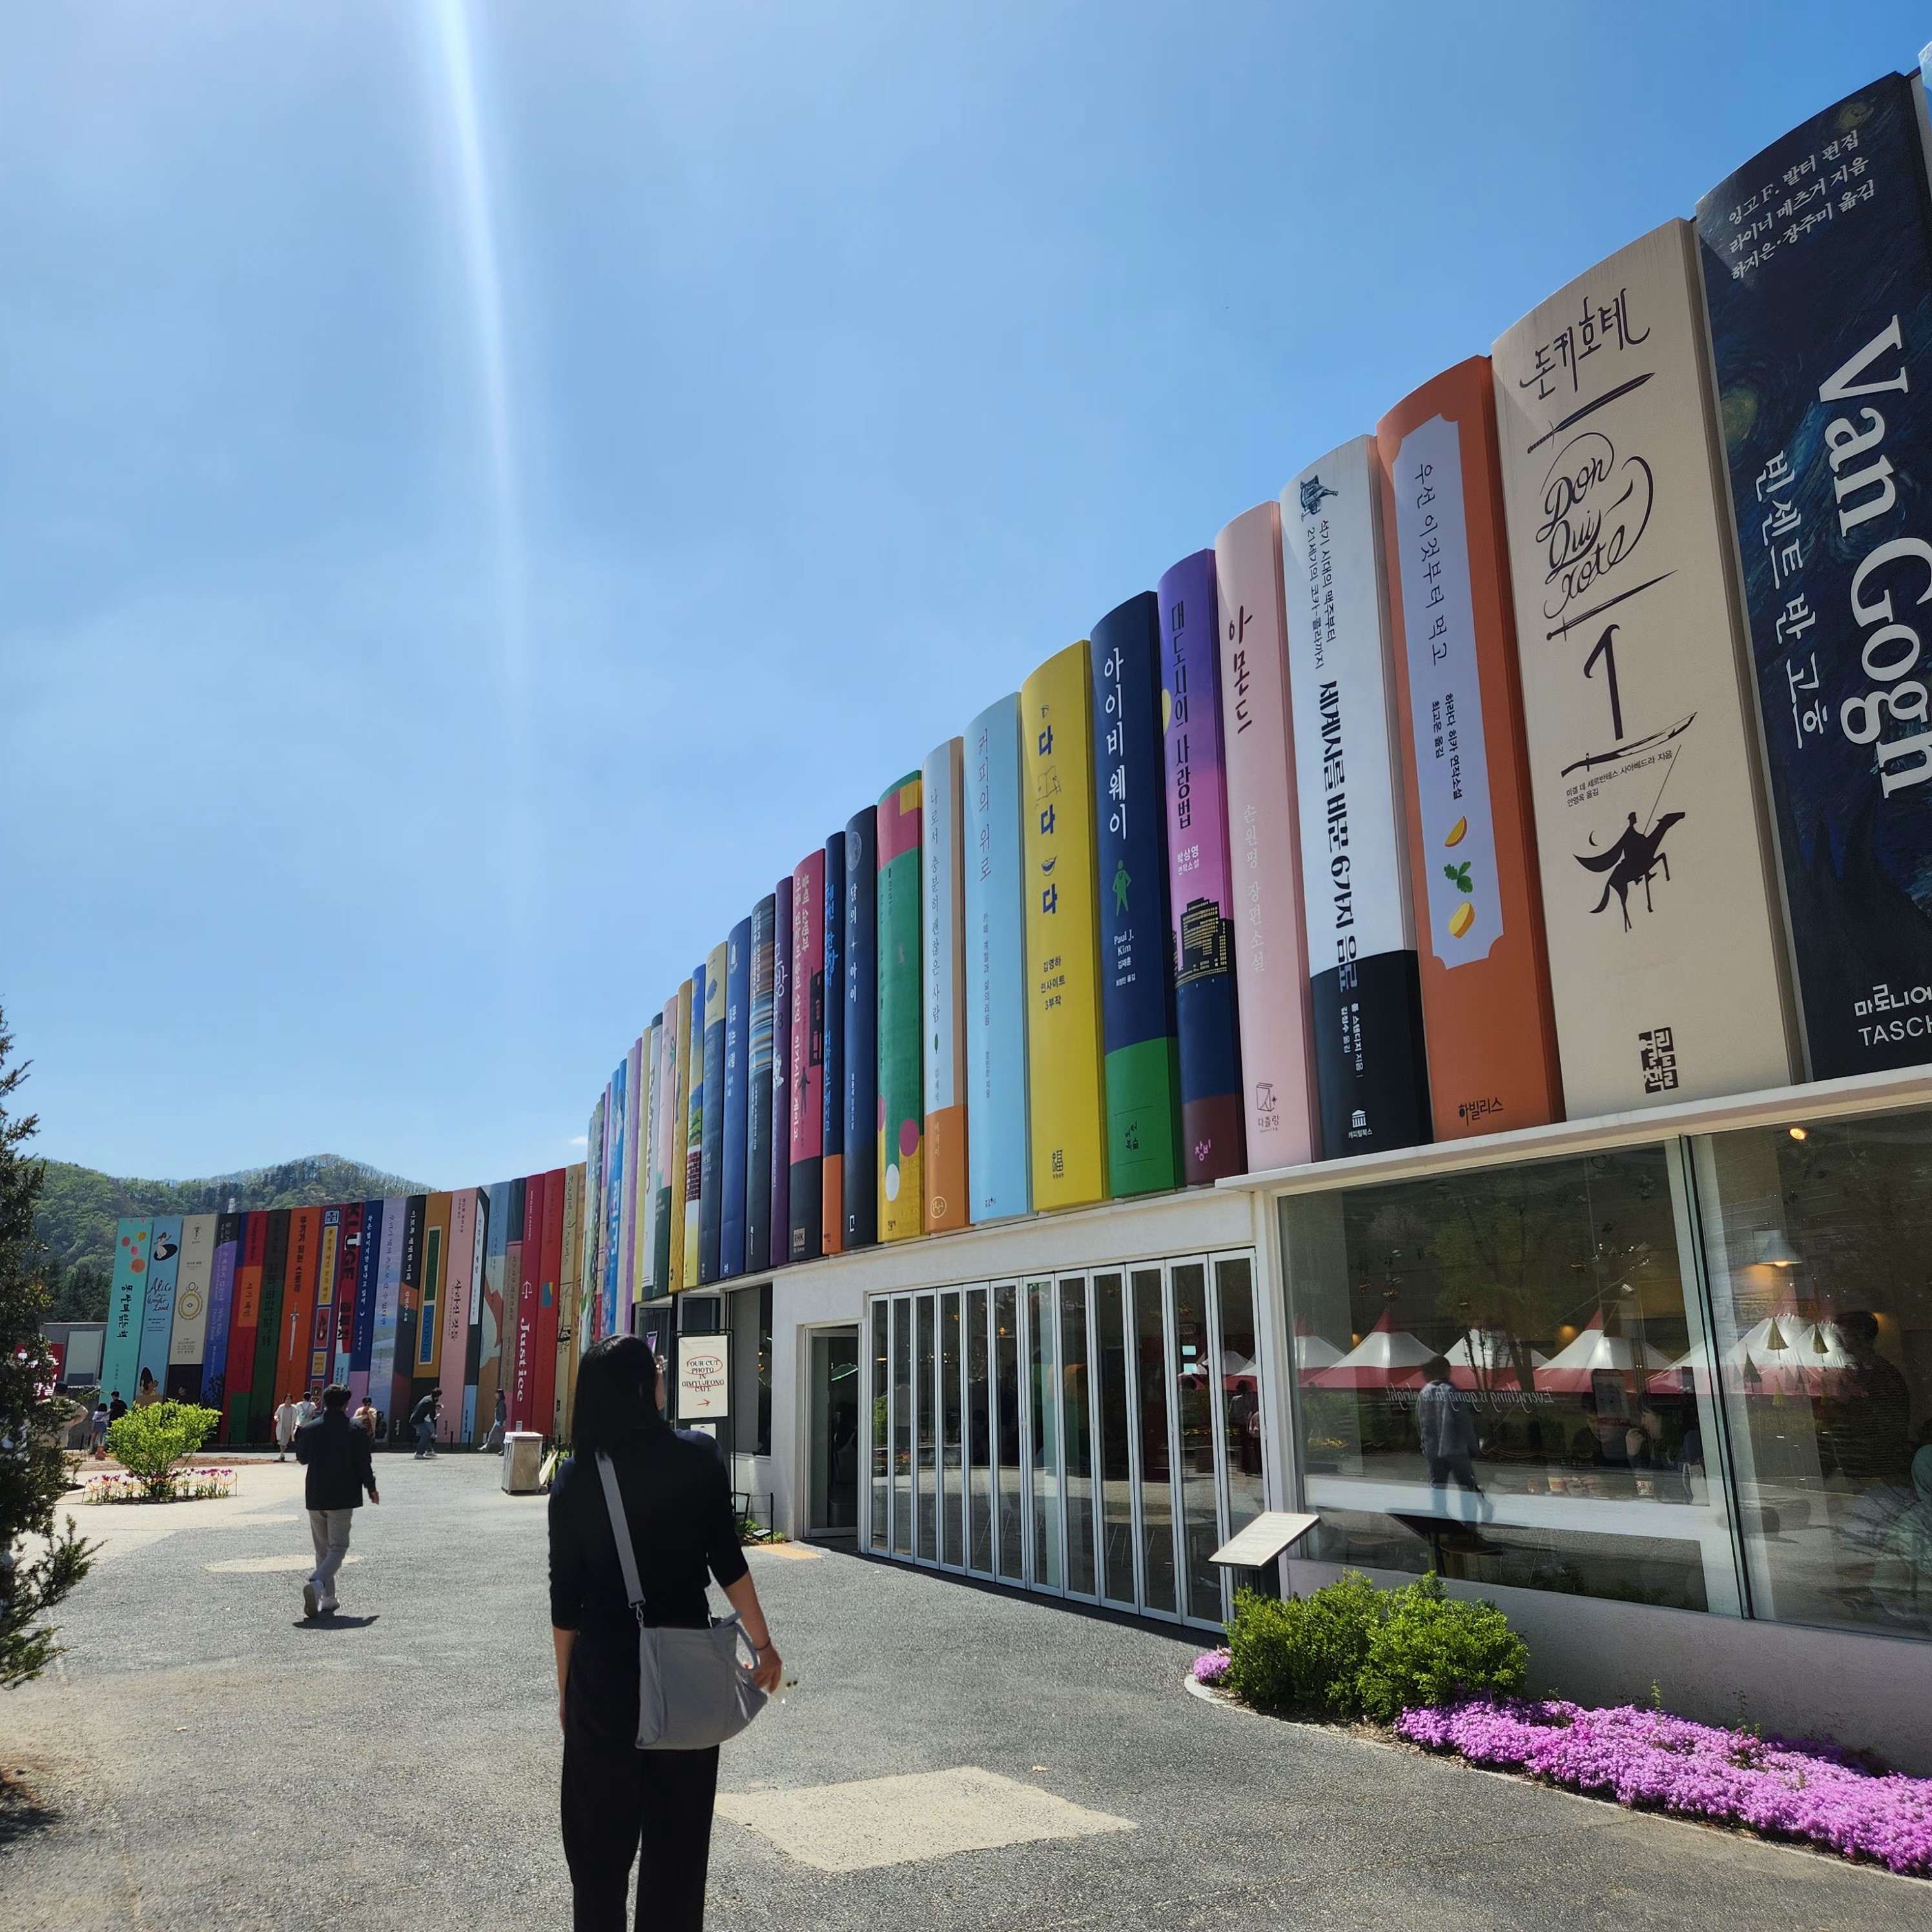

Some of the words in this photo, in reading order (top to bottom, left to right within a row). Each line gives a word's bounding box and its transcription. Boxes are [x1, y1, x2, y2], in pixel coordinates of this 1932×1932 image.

[1729, 195, 1759, 225] 잉고
[1761, 183, 1780, 203] F.
[1783, 155, 1816, 187] 발터
[1822, 130, 1859, 161] 편집
[1838, 179, 1875, 213] 옮김
[1729, 213, 1773, 253] 라이너
[1776, 178, 1827, 220] 메츠거
[1830, 156, 1869, 189] 지음
[1520, 288, 1650, 400] 돈키호테
[1818, 314, 1909, 539] Van
[1415, 463, 1437, 509] 우선
[1536, 439, 1614, 544] Don
[1319, 519, 1330, 546] 석기
[1756, 450, 1804, 590] 빈센트
[1307, 527, 1319, 582] 21세기의
[1322, 550, 1333, 588] 시대의
[1419, 515, 1445, 609] 이것부터
[1310, 584, 1324, 670] 코카-콜라까지
[1323, 590, 1337, 644] 맥주부터
[1777, 592, 1816, 644] 반
[1428, 615, 1448, 666] 먹고
[1171, 601, 1188, 728] 대도시의
[1229, 604, 1253, 734] 아몬드
[1584, 624, 1623, 741] 1
[1840, 537, 1932, 799] Gogh
[1432, 700, 1443, 734] 최고은
[1444, 692, 1456, 727] 하라다
[1786, 652, 1829, 749] 고흐
[1038, 724, 1054, 756] 다
[1104, 646, 1127, 841] 아이비웨이
[1319, 680, 1345, 793] 세계사를
[1434, 735, 1444, 759] 옮김
[1448, 728, 1459, 753] 히카
[978, 728, 989, 812] 커피의
[1175, 733, 1191, 830] 사랑법
[1450, 754, 1463, 801] 연작소설
[1579, 782, 1586, 791] 데
[1658, 750, 1673, 762] 지음
[930, 788, 939, 845] 나로서
[1567, 795, 1585, 808] 안영옥
[1586, 787, 1599, 800] 옮김
[1040, 804, 1055, 836] 다
[1244, 804, 1259, 869] 손원평
[1326, 792, 1350, 854] 바꾼
[980, 823, 991, 881] 위로
[1177, 845, 1199, 864] 박상영
[1178, 858, 1199, 876] 연작소설
[1043, 883, 1058, 914] 다
[1330, 855, 1355, 929] 6가지
[1114, 930, 1127, 945] Paul
[1128, 929, 1135, 941] J.
[1248, 881, 1264, 972] 장편소설
[1043, 956, 1062, 972] 김영하
[1117, 944, 1131, 956] Kim
[1337, 934, 1359, 994] 음료
[850, 967, 858, 1003] 아이
[932, 983, 940, 1023] 사람
[1040, 974, 1065, 994] 인사이트
[1045, 994, 1062, 1011] 3부작
[1341, 1005, 1350, 1034] 김정수
[1343, 1034, 1351, 1054] 옮김
[1356, 1052, 1364, 1073] 지음
[1458, 1098, 1504, 1126] 하빌리스
[1195, 1139, 1211, 1161] 창비
[385, 1238, 393, 1254] 빛의
[794, 1231, 805, 1242] RHK
[147, 1277, 172, 1294] Alice
[406, 1264, 413, 1280] 미래
[382, 1291, 388, 1300] 수
[453, 1278, 462, 1315] 사라진
[117, 1330, 128, 1339] 책
[118, 1314, 128, 1329] 읽는
[422, 1311, 432, 1359] STONER
[451, 1317, 459, 1341] 것들
[516, 1317, 530, 1403] Justice
